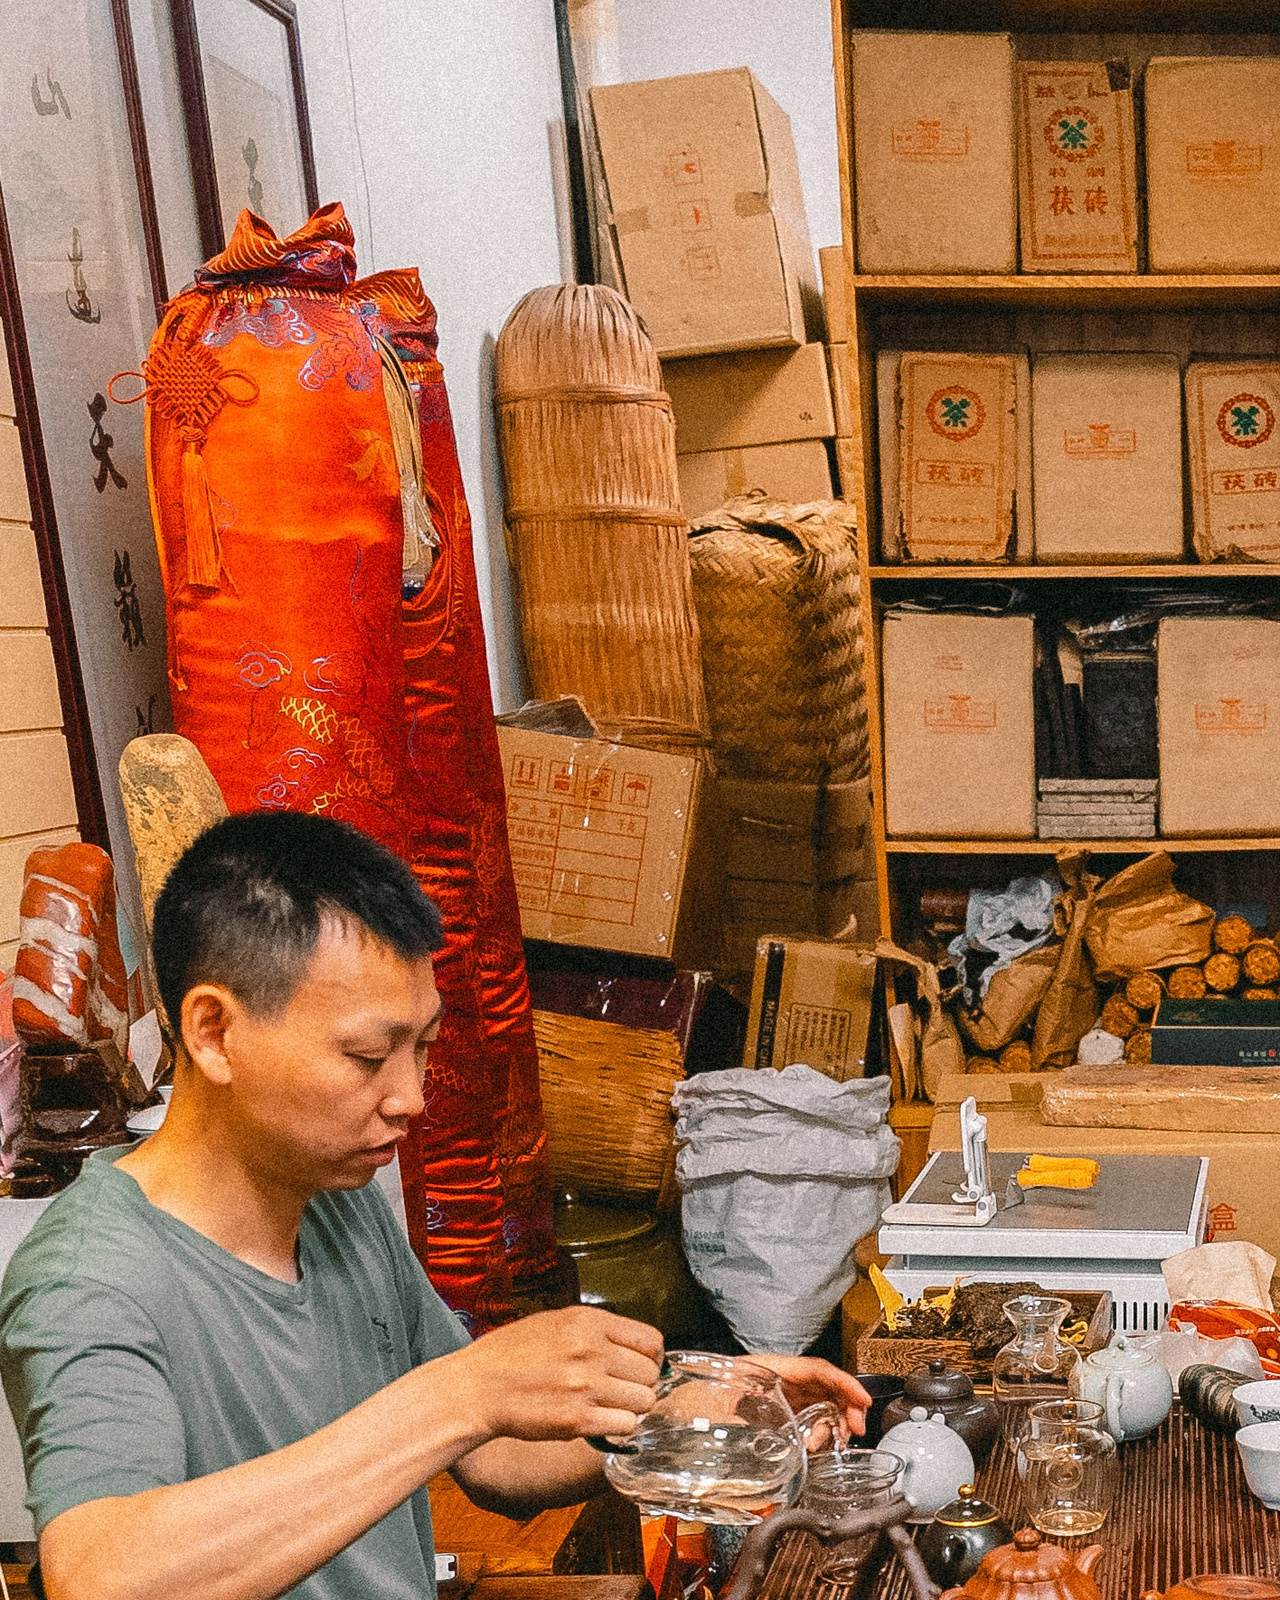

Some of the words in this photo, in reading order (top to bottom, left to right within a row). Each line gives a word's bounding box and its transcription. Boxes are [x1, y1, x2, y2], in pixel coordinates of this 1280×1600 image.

[1050, 186, 1108, 216] 茯砖
[926, 463, 985, 484] 茯砖
[1220, 471, 1279, 492] 茯砖
[762, 1000, 775, 1034] MADE
